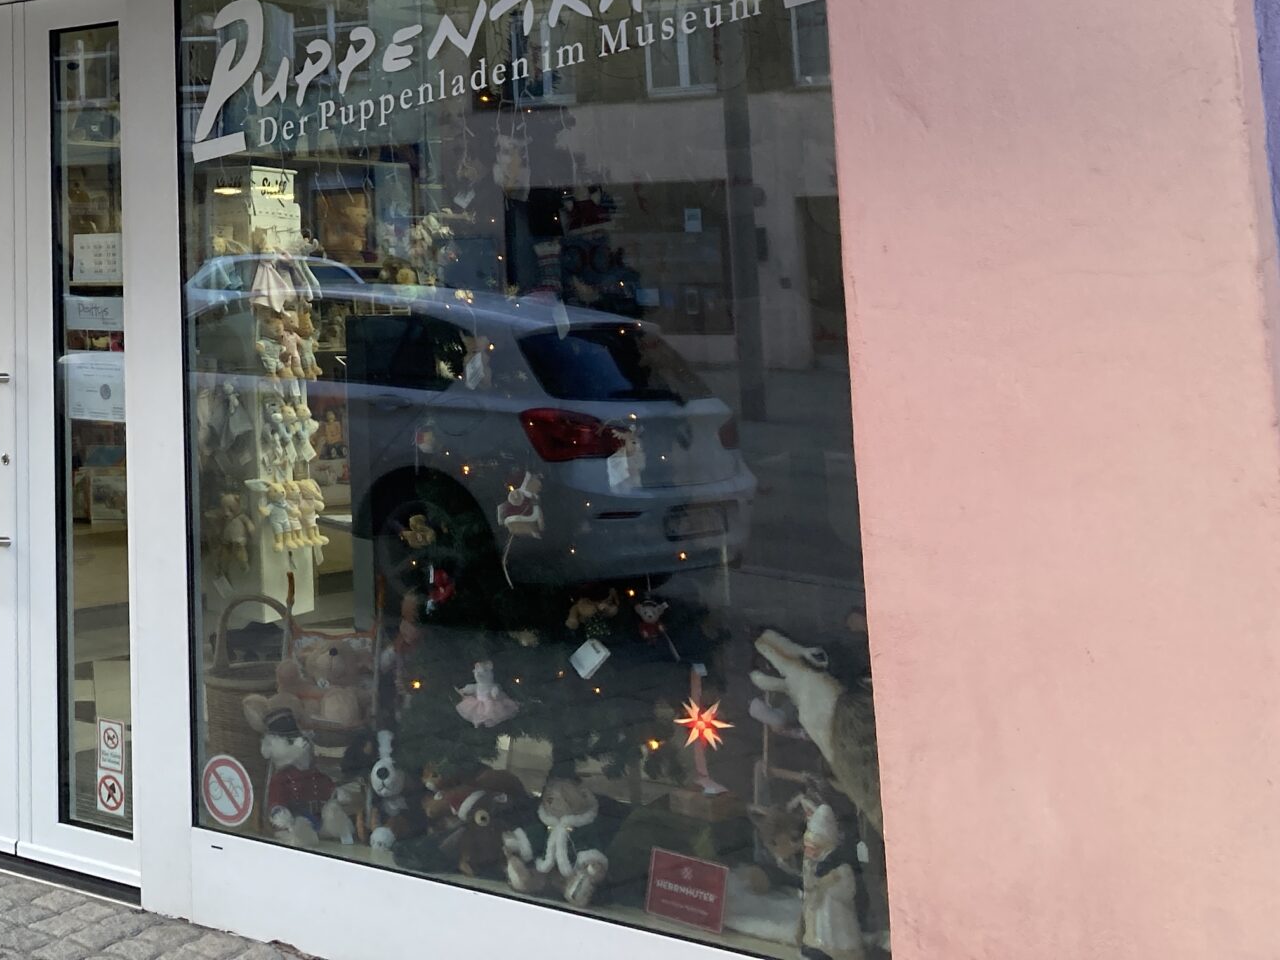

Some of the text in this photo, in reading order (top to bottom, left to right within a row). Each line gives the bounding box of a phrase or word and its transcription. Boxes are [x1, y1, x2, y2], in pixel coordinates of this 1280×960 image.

[257, 117, 307, 147] Der
[319, 55, 530, 132] Puppenladen
[542, 37, 585, 73] im
